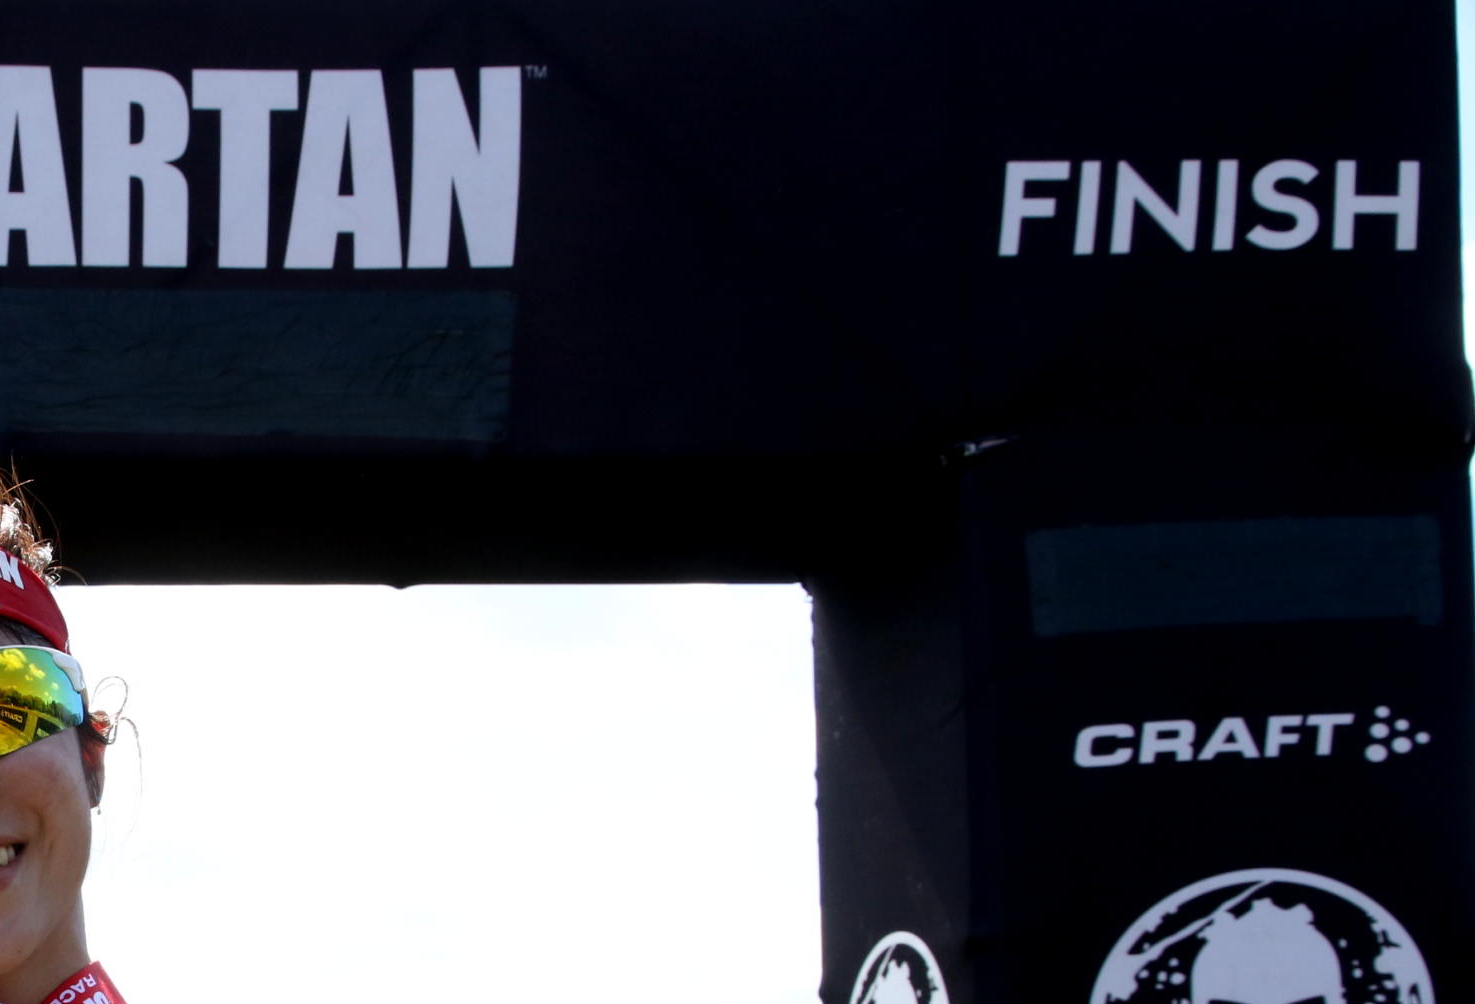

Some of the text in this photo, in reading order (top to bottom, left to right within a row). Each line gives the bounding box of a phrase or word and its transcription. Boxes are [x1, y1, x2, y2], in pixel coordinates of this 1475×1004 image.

[525, 65, 547, 79] TM
[1000, 160, 1419, 255] FINISH
[1075, 714, 1353, 767] CRAFT
